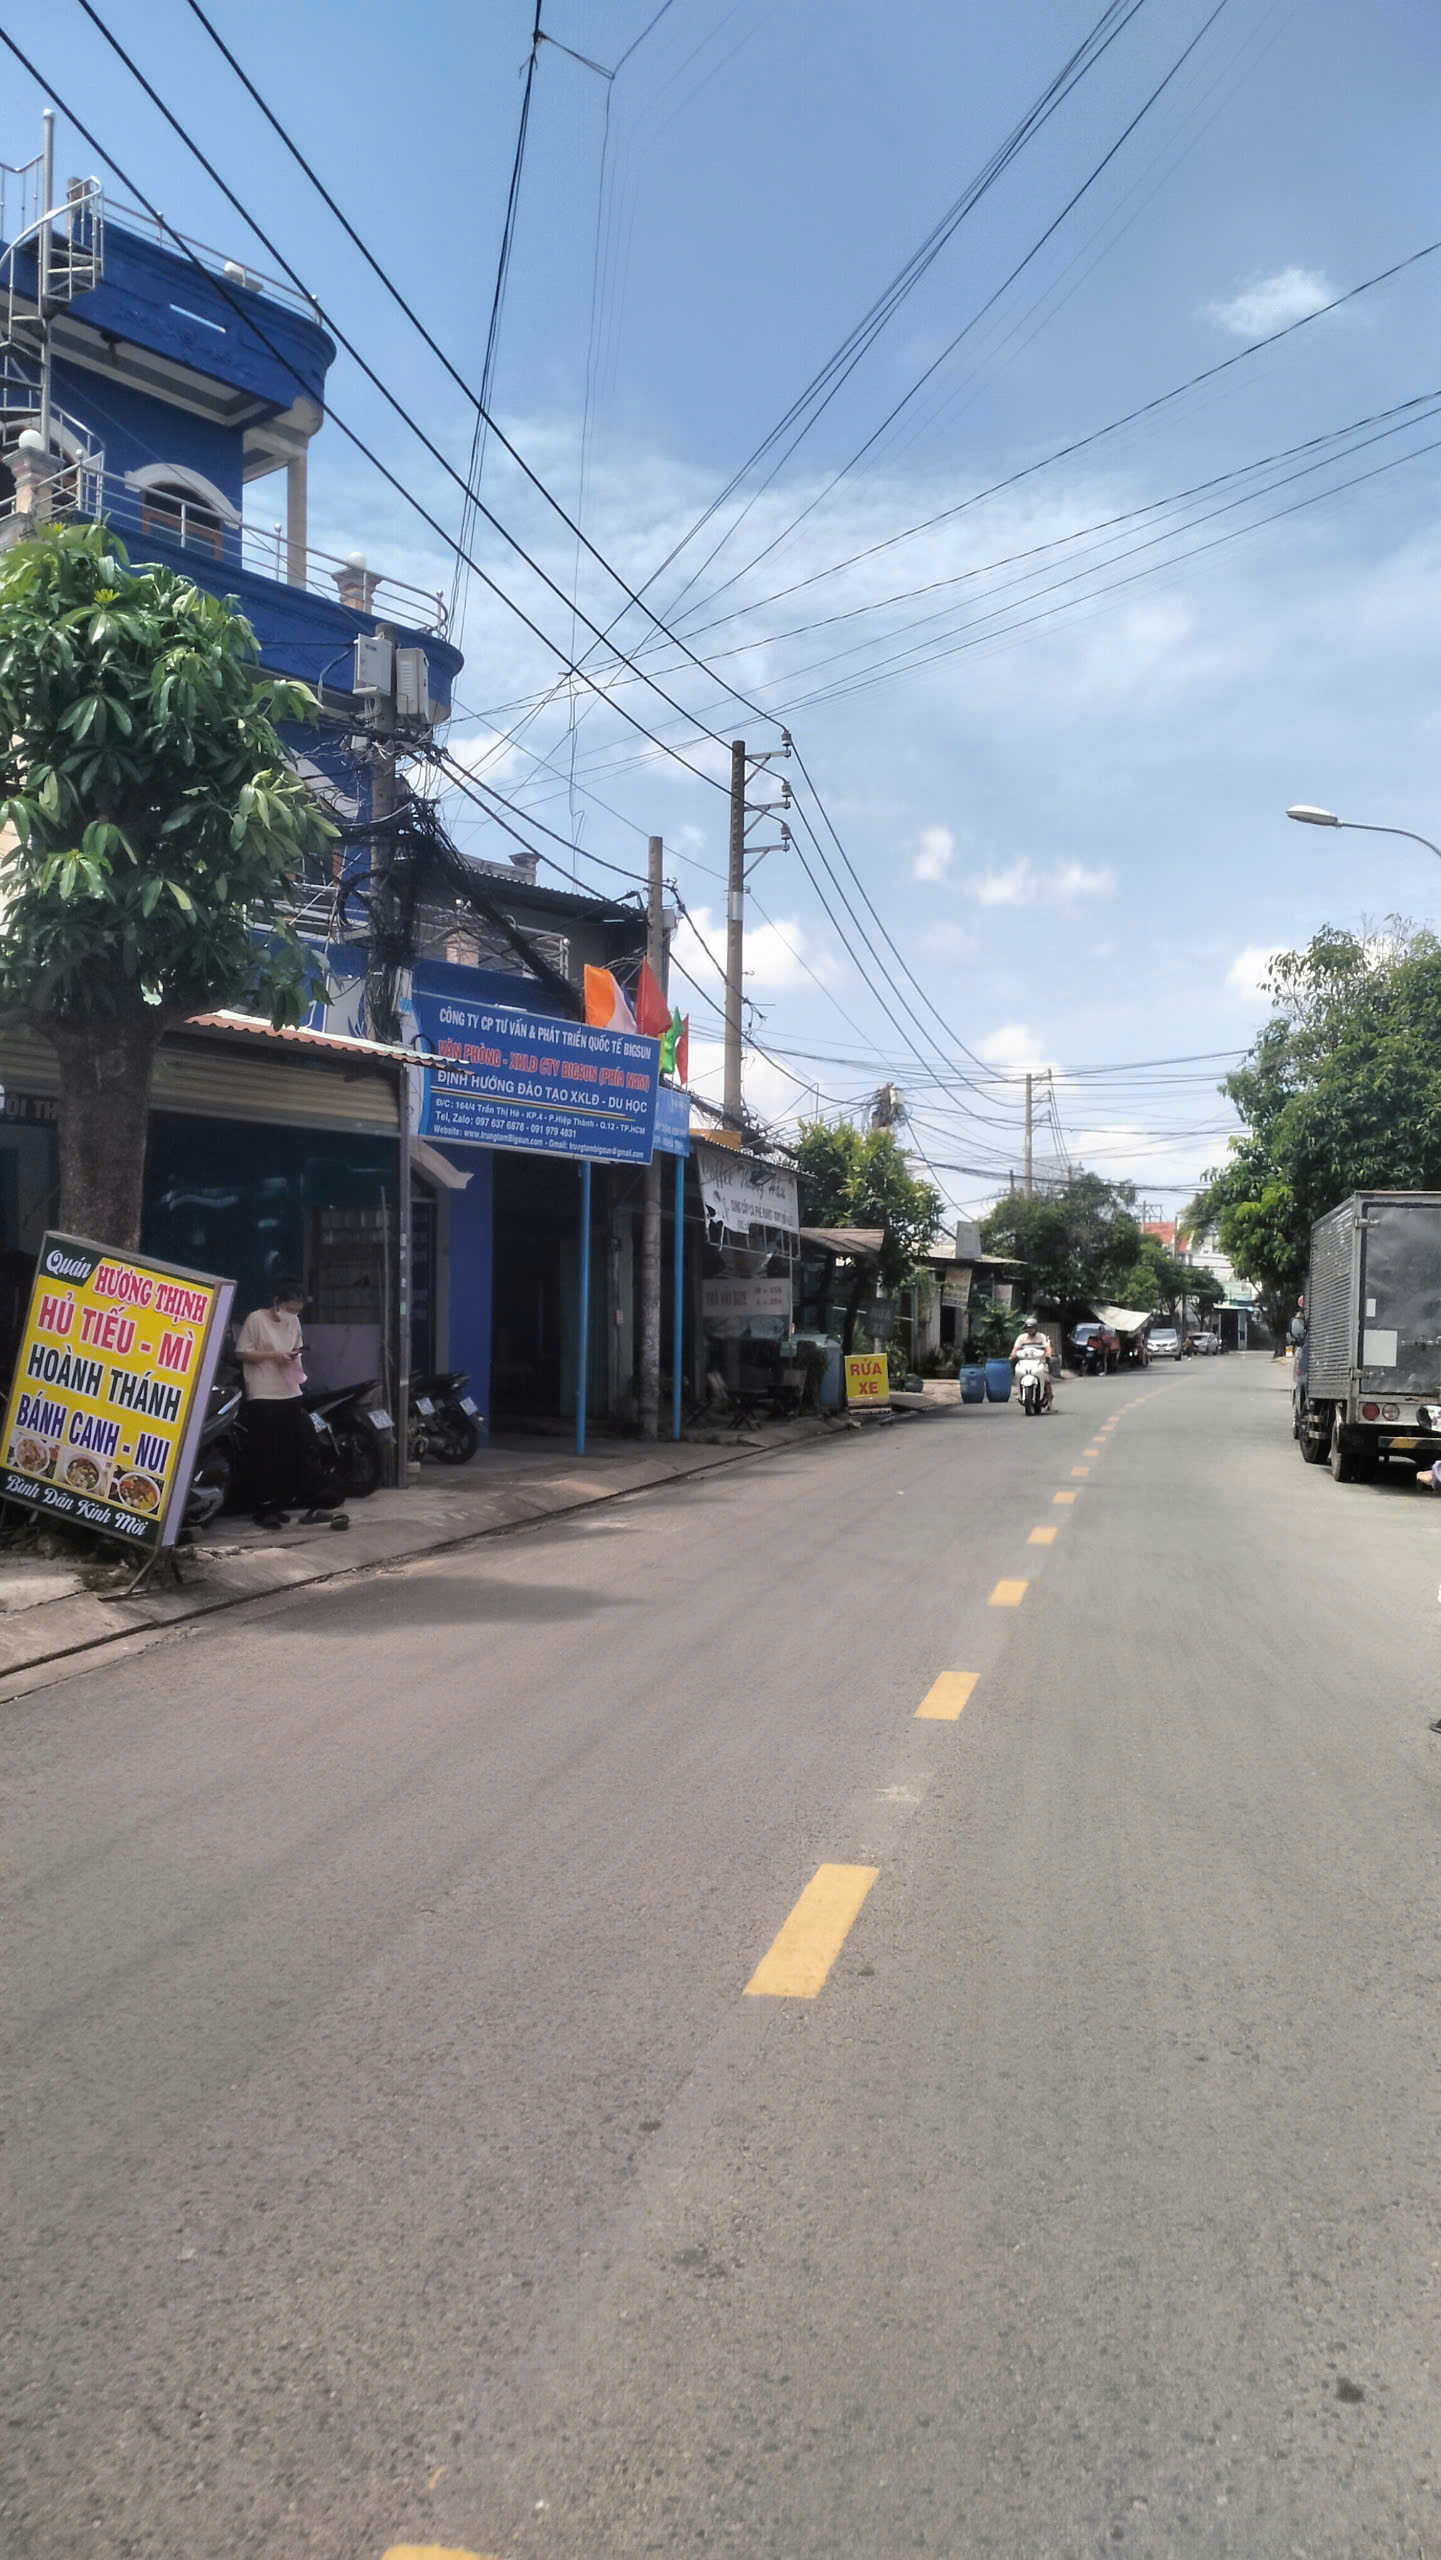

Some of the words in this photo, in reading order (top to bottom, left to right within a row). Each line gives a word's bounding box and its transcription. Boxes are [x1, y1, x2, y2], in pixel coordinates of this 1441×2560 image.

[440, 1006, 465, 1027] CÔNG
[467, 1013, 479, 1029] TY
[481, 1016, 493, 1031] CP
[496, 1018, 508, 1034] TƯ
[510, 1018, 527, 1038] VẤN
[529, 1025, 536, 1039] &
[538, 1026, 560, 1044] PHÁT
[562, 1027, 586, 1048] TRIỂN
[588, 1034, 610, 1052] QUỐC
[612, 1037, 624, 1055] TẾ
[624, 1043, 651, 1059] BIGSUN
[438, 1037, 462, 1060] VĂN
[464, 1043, 502, 1067] PHÒNG
[510, 1051, 538, 1073] XKLĐ
[540, 1057, 560, 1076] CTY
[562, 1061, 597, 1083] BIGSUN
[599, 1066, 624, 1087] (PHÍA
[626, 1072, 650, 1093] NAM)
[438, 1070, 467, 1086] ĐỊNH
[471, 1074, 514, 1093] HƯỚNG
[518, 1081, 542, 1097] ĐÀO
[545, 1087, 569, 1102] TẠO
[570, 1091, 600, 1105] XKLĐ
[608, 1097, 623, 1109] DU
[625, 1099, 647, 1113] HỌC
[436, 1099, 454, 1108] Đ/C:
[455, 1101, 475, 1111] 164/4
[573, 1117, 594, 1128] Thành
[475, 1116, 489, 1127] 097
[491, 1119, 505, 1129] 637
[530, 1124, 543, 1134] 091
[46, 1250, 92, 1279] Quán
[94, 1265, 153, 1307] HƯƠNG
[155, 1283, 208, 1325] THỊNH
[38, 1292, 75, 1335] HỦ
[81, 1306, 135, 1354] TIẾU
[141, 1343, 151, 1352] -
[158, 1331, 193, 1373] MÌ
[27, 1344, 103, 1397] HOÀNH
[109, 1369, 182, 1422] THÁNH
[850, 1358, 882, 1376] RỬA
[858, 1382, 878, 1394] XE
[16, 1391, 67, 1439] BÁNH
[69, 1411, 120, 1457] CANH
[122, 1444, 130, 1453] -
[134, 1433, 170, 1474] NUI
[5, 1474, 40, 1499] Bình
[44, 1488, 73, 1511] Dân
[77, 1499, 112, 1523] Kính
[115, 1512, 149, 1537] Mời
